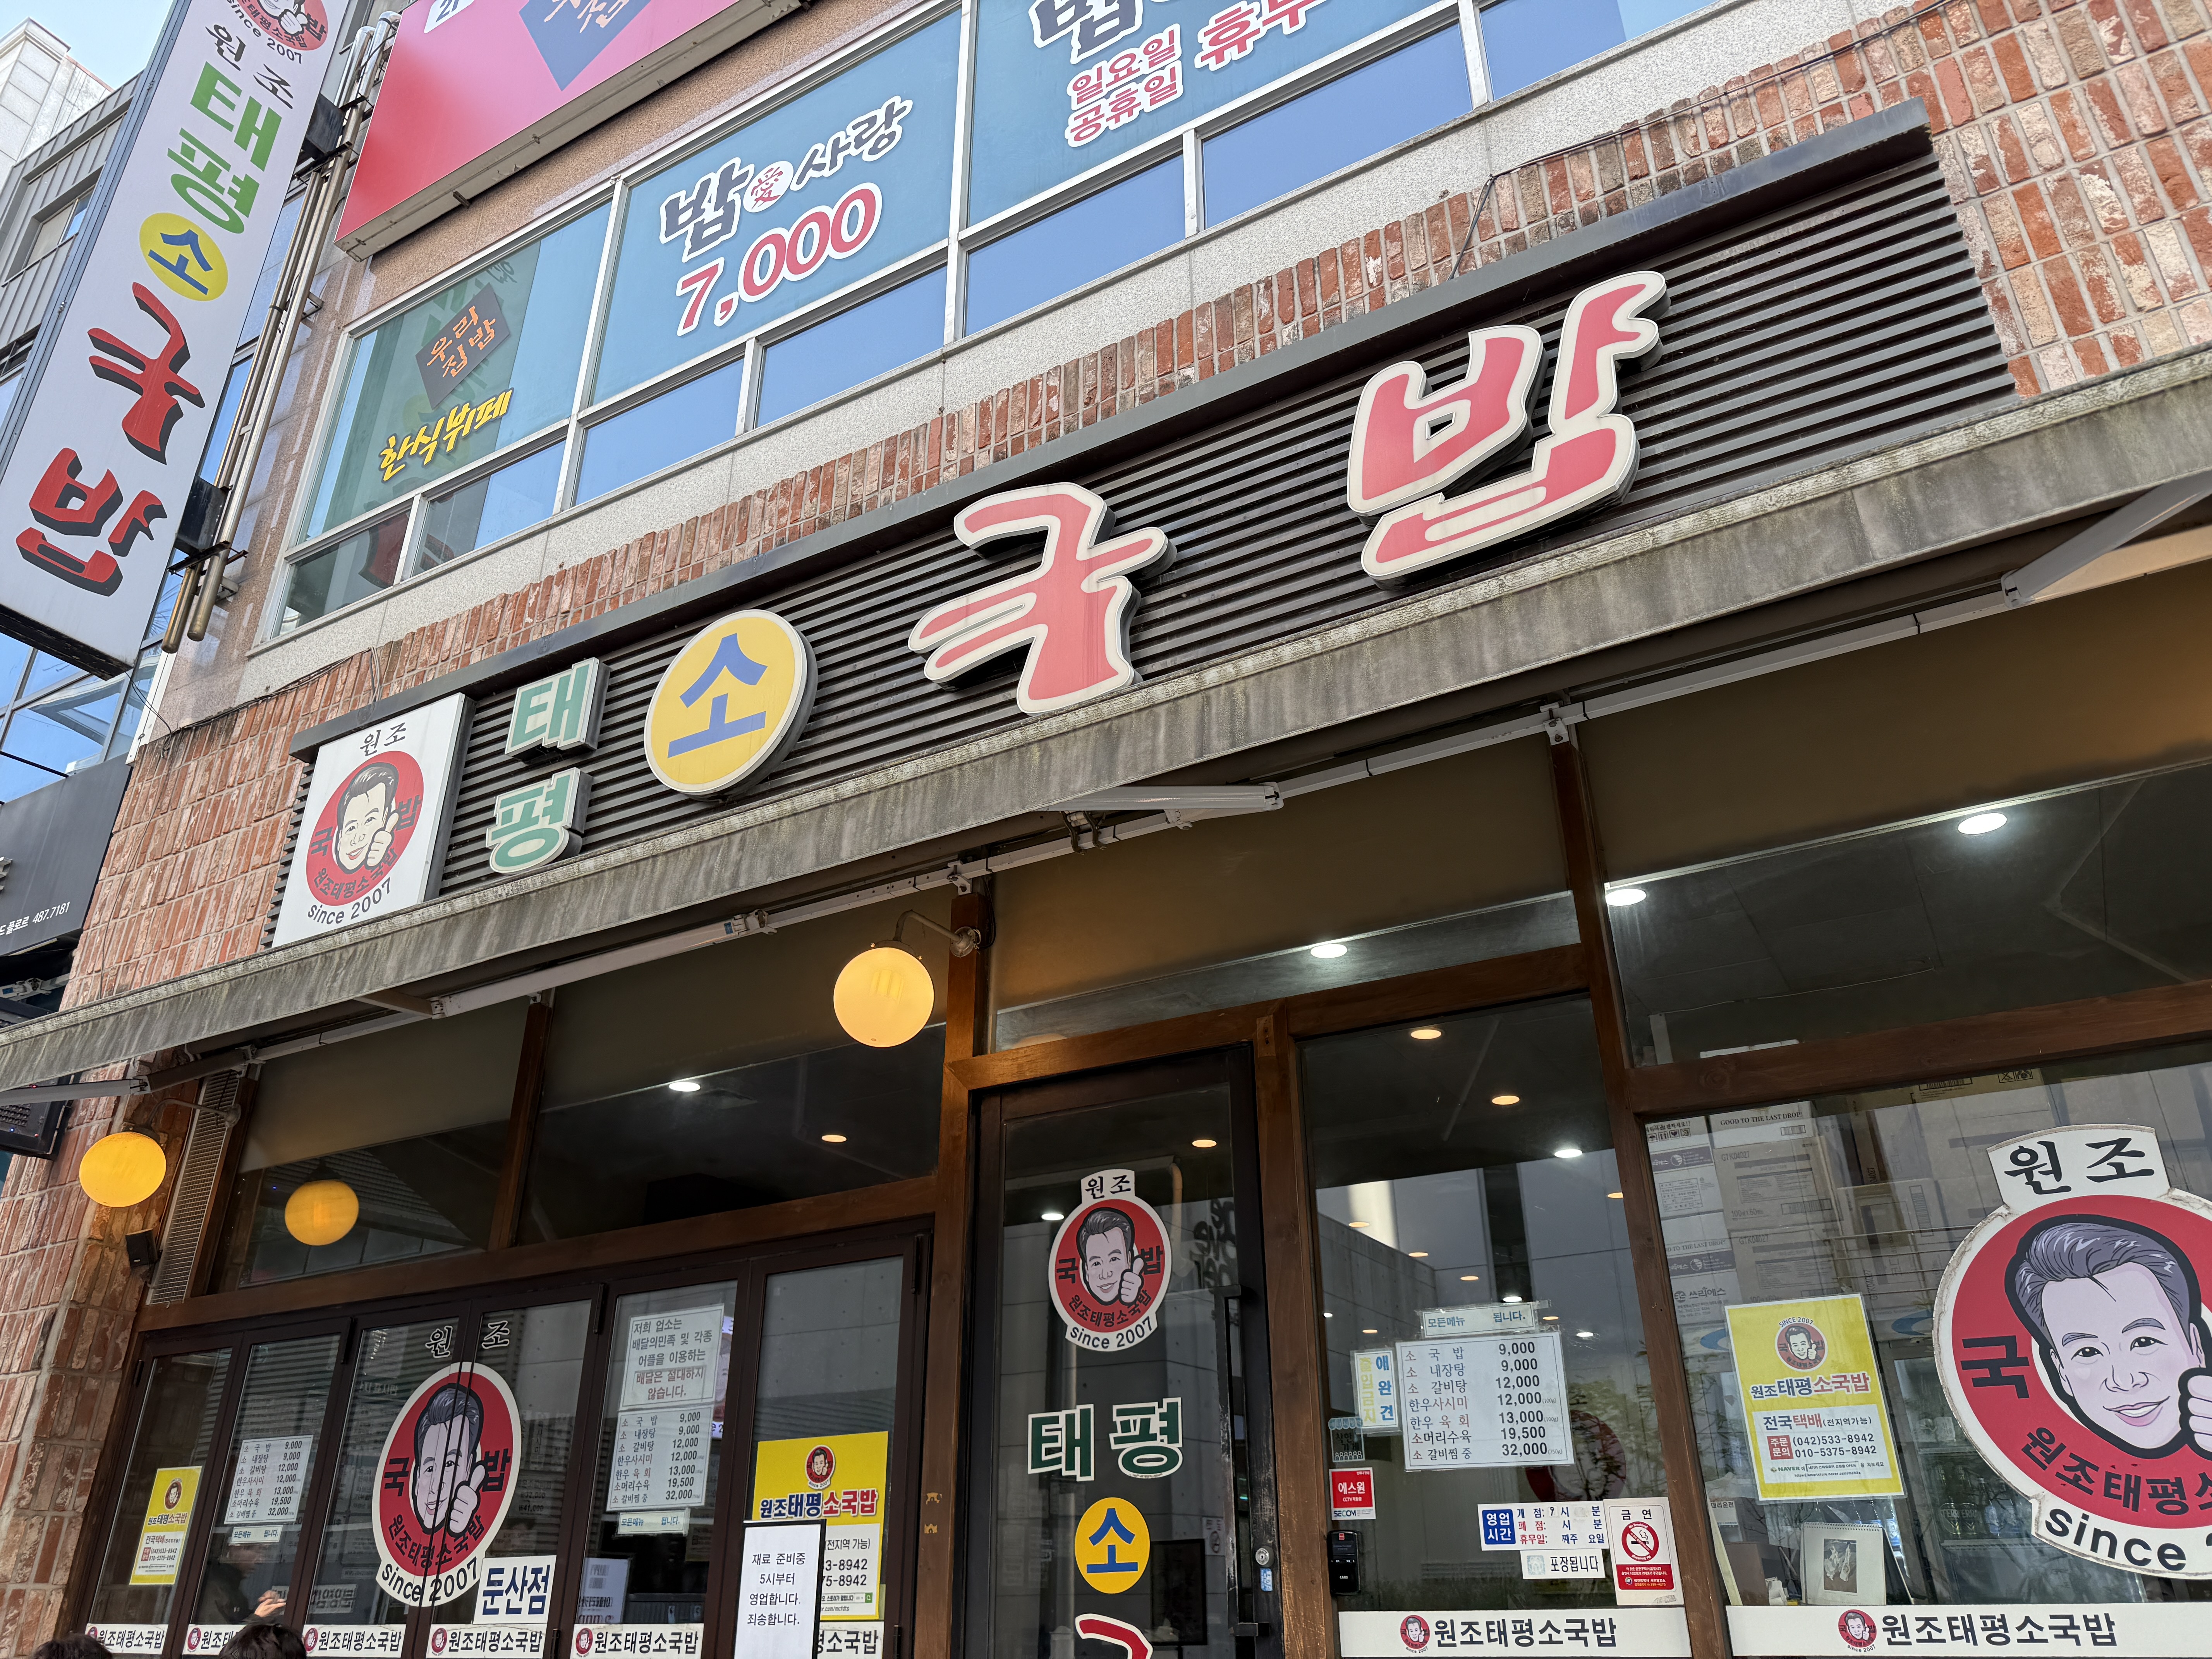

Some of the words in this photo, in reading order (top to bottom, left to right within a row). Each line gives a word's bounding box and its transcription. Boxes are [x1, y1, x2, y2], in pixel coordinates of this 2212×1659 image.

[267, 38, 302, 64] 2007
[205, 24, 294, 109] 원조
[1072, 31, 1176, 105] 일요일
[1070, 66, 1178, 143] 공휴일
[167, 61, 282, 234] 태평
[663, 162, 751, 256] 밥
[797, 101, 907, 157] 사랑
[148, 229, 213, 295] 소
[680, 187, 877, 331] 7,000
[427, 305, 479, 366] 우리
[442, 318, 496, 378] 집밥
[16, 282, 205, 597] 국밥
[380, 388, 514, 482] 한식뷔페
[667, 632, 769, 759] 소
[360, 722, 406, 756] 원조
[489, 661, 594, 870] 태평
[311, 826, 333, 856] 국
[397, 795, 421, 831] 밥
[308, 903, 344, 924] since
[351, 877, 391, 920] 2007
[33, 902, 70, 924] 487.7181
[2004, 1137, 2155, 1195] 원조
[1085, 1175, 1131, 1199] 원조
[1056, 1257, 1078, 1284] 국
[1141, 1245, 1163, 1275] 밥
[1689, 1287, 1727, 1298] 쓰리에스
[1068, 1290, 1152, 1328] 원조태평소국밥
[634, 1321, 651, 1334] 저희
[656, 1318, 682, 1333] 업소는
[1428, 1316, 1465, 1328] 모든메뉴
[1493, 1310, 1525, 1322] 됩니다.
[1779, 1317, 1796, 1327] SINCE
[426, 1321, 510, 1358] 원조
[632, 1334, 675, 1350] 배달의민족
[680, 1332, 689, 1345] 및
[694, 1330, 712, 1343] 각종
[1070, 1326, 1110, 1349] since
[1116, 1316, 1152, 1348] 2007
[639, 1353, 665, 1367] 어플을
[669, 1348, 706, 1363] 이용하는
[1405, 1351, 1416, 1361] 소
[1499, 1342, 1535, 1356] 9,000
[636, 1370, 663, 1384] 배달은
[668, 1367, 704, 1382] 절대하지
[1406, 1367, 1418, 1377] 소
[1430, 1363, 1465, 1377] 내장탕
[1501, 1358, 1537, 1373] 9,000
[1961, 1334, 2030, 1399] 국
[648, 1385, 686, 1400] 않습니다.
[1376, 1355, 1394, 1421] 애완견
[1407, 1383, 1419, 1394] 소
[1431, 1379, 1467, 1394] 갈비탕
[1496, 1375, 1540, 1389] 12,000
[1751, 1373, 1870, 1399] 원조태평소국밥
[1409, 1396, 1467, 1413] 한우사시미
[1497, 1392, 1541, 1407] 12,000
[622, 1419, 628, 1427] 소
[680, 1412, 700, 1423] 9,000
[1410, 1416, 1434, 1430] 한우
[1439, 1415, 1451, 1428] 육
[1458, 1414, 1469, 1428] 회
[1499, 1410, 1543, 1425] 13,000
[1763, 1413, 1822, 1431] 전국택배
[1823, 1417, 1872, 1427] (전지역가능)
[635, 1428, 656, 1439] 내장탕
[679, 1424, 699, 1436] 9,000
[1030, 1399, 1182, 1479] 태평
[1411, 1430, 1471, 1445] 소머리수육
[1501, 1426, 1546, 1441] 19,500
[1770, 1438, 1788, 1447] 주문
[1793, 1433, 1874, 1446] (042)533-8942
[285, 1441, 302, 1449] 9,000
[618, 1444, 625, 1452] 소
[633, 1441, 654, 1452] 갈비탕
[673, 1437, 698, 1448] 12,000
[1412, 1450, 1423, 1460] 소
[1427, 1448, 1458, 1461] 갈비찜
[1461, 1448, 1472, 1460] 중
[1502, 1443, 1547, 1457] 32,000
[1772, 1448, 1790, 1457] 문의
[1795, 1446, 1877, 1458] 010-5375-8942
[252, 1454, 269, 1463] 내장탕
[283, 1452, 300, 1461] 9,000
[618, 1454, 652, 1466] 한우사시미
[671, 1451, 697, 1462] 12,000
[250, 1465, 267, 1475] 갈비탕
[278, 1463, 298, 1472] 12,000
[384, 1457, 410, 1497] 국
[482, 1448, 511, 1492] 밥
[616, 1469, 629, 1480] 한우
[669, 1465, 695, 1475] 13,000
[237, 1476, 264, 1486] 한우사시미
[276, 1474, 297, 1483] 12,000
[614, 1480, 649, 1491] 소머리수육
[668, 1477, 694, 1488] 19,500
[1338, 1481, 1365, 1494] 에스원
[234, 1489, 244, 1498] 한우
[274, 1486, 294, 1495] 13,000
[642, 1494, 647, 1502] 중
[666, 1489, 692, 1501] 32,000
[231, 1498, 259, 1508] 소머리수육
[271, 1496, 291, 1506] 19,500
[268, 1507, 289, 1516] 32,000
[760, 1488, 877, 1518] 원조태평소국밥
[1561, 1506, 1569, 1517] 시
[1592, 1506, 1600, 1516] 분
[1486, 1513, 1510, 1526] 영업
[1563, 1520, 1571, 1530] 시
[1593, 1519, 1602, 1529] 분
[852, 1538, 871, 1549] 가능)
[1087, 1508, 1139, 1573] 소
[1487, 1528, 1511, 1541] 시간
[1520, 1534, 1547, 1544] 휴무일:
[1588, 1533, 1604, 1544] 요일
[2045, 1509, 2186, 1571] since
[752, 1553, 770, 1565] 재료
[776, 1553, 805, 1565] 준비중
[1550, 1555, 1599, 1572] 포장됩니다
[382, 1563, 422, 1602] since
[429, 1556, 477, 1602] 2007
[760, 1573, 795, 1585] 5시부터
[482, 1565, 550, 1615] 둔산점
[749, 1593, 800, 1606] 영업합니다.
[747, 1613, 800, 1626] 죄송합니다.
[99, 1630, 164, 1649] 원조태평소국밥
[1434, 1618, 1616, 1647] 원조태평소국밥
[1882, 1613, 2118, 1647] 원조태평소국밥
[318, 1630, 402, 1652] 원조태평소국밥
[448, 1630, 542, 1653] 원조태평소국밥
[595, 1631, 698, 1654] 원조태평소국밥
